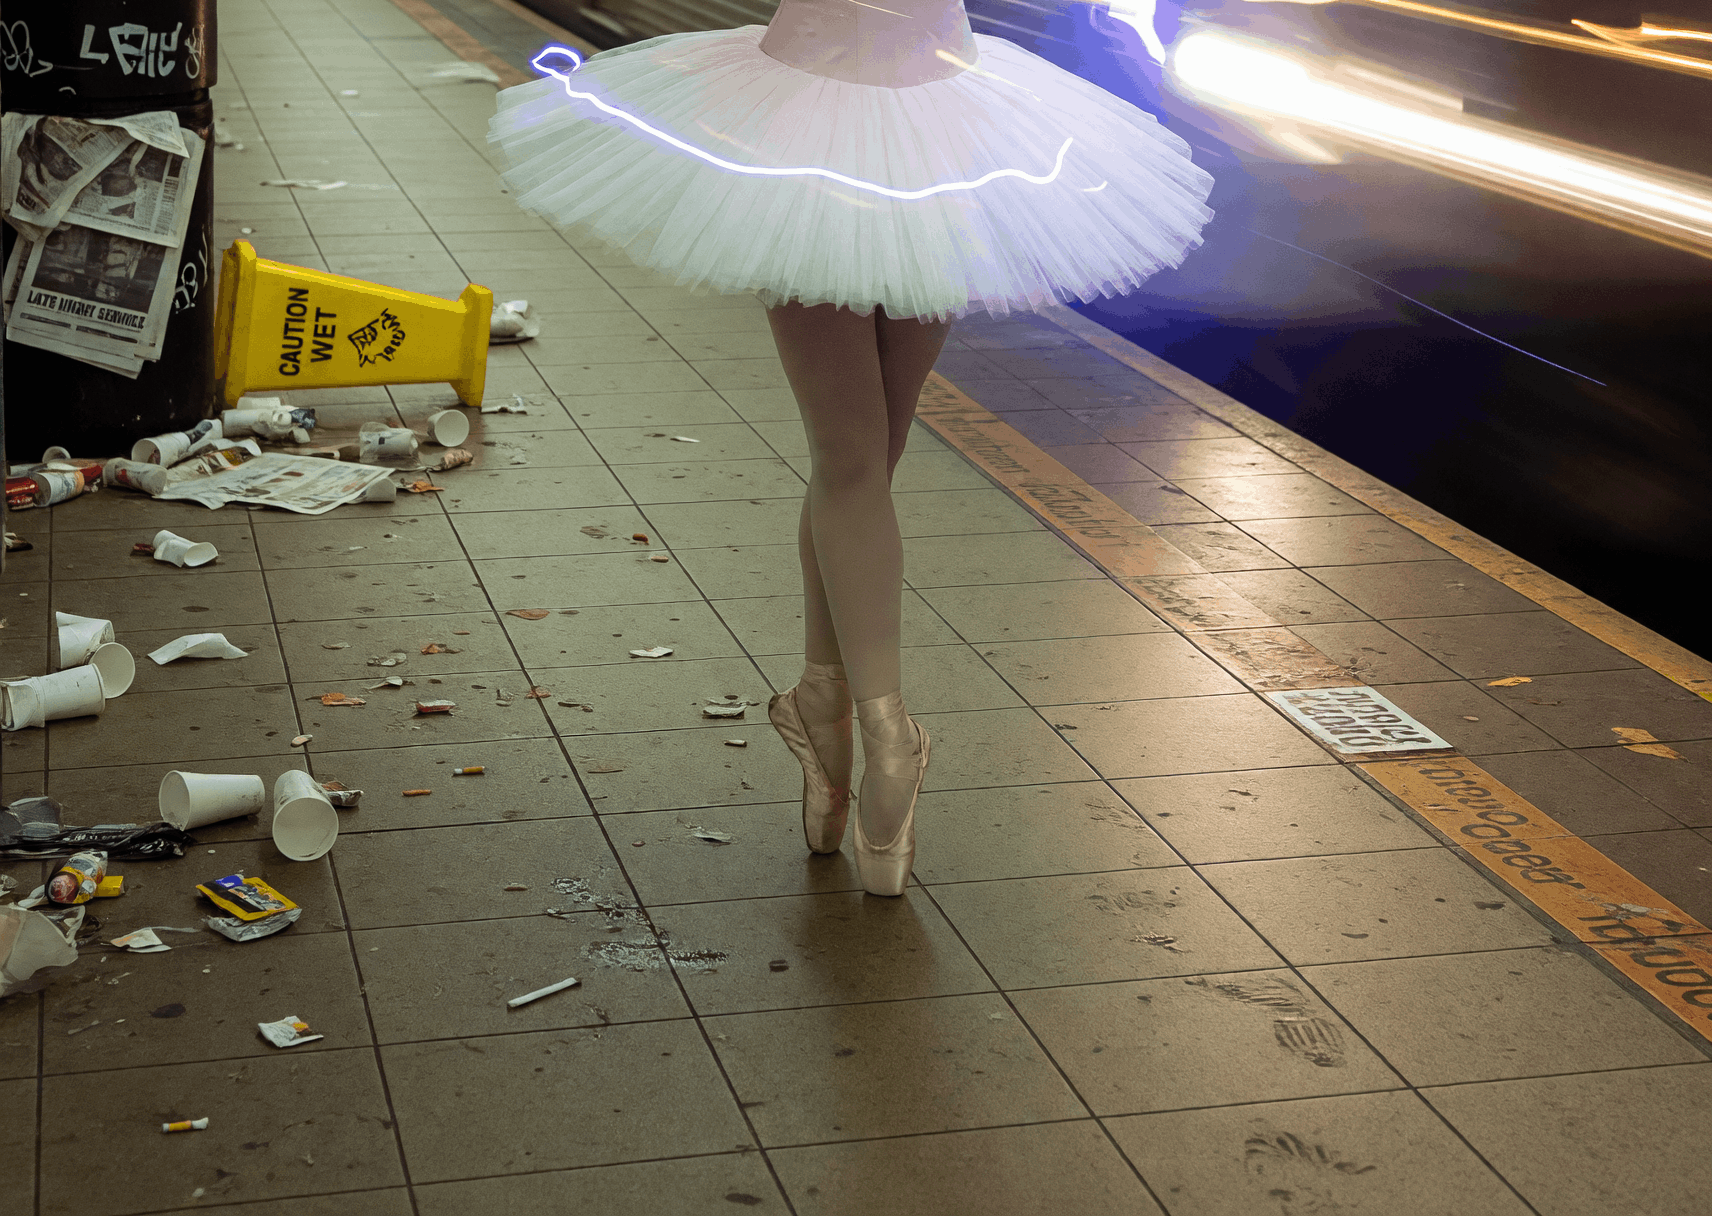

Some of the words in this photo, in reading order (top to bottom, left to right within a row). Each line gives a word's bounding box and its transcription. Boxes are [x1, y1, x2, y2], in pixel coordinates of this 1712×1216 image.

[27, 290, 58, 310] LATE
[279, 287, 309, 376] CAUTION
[310, 306, 337, 363] WET
